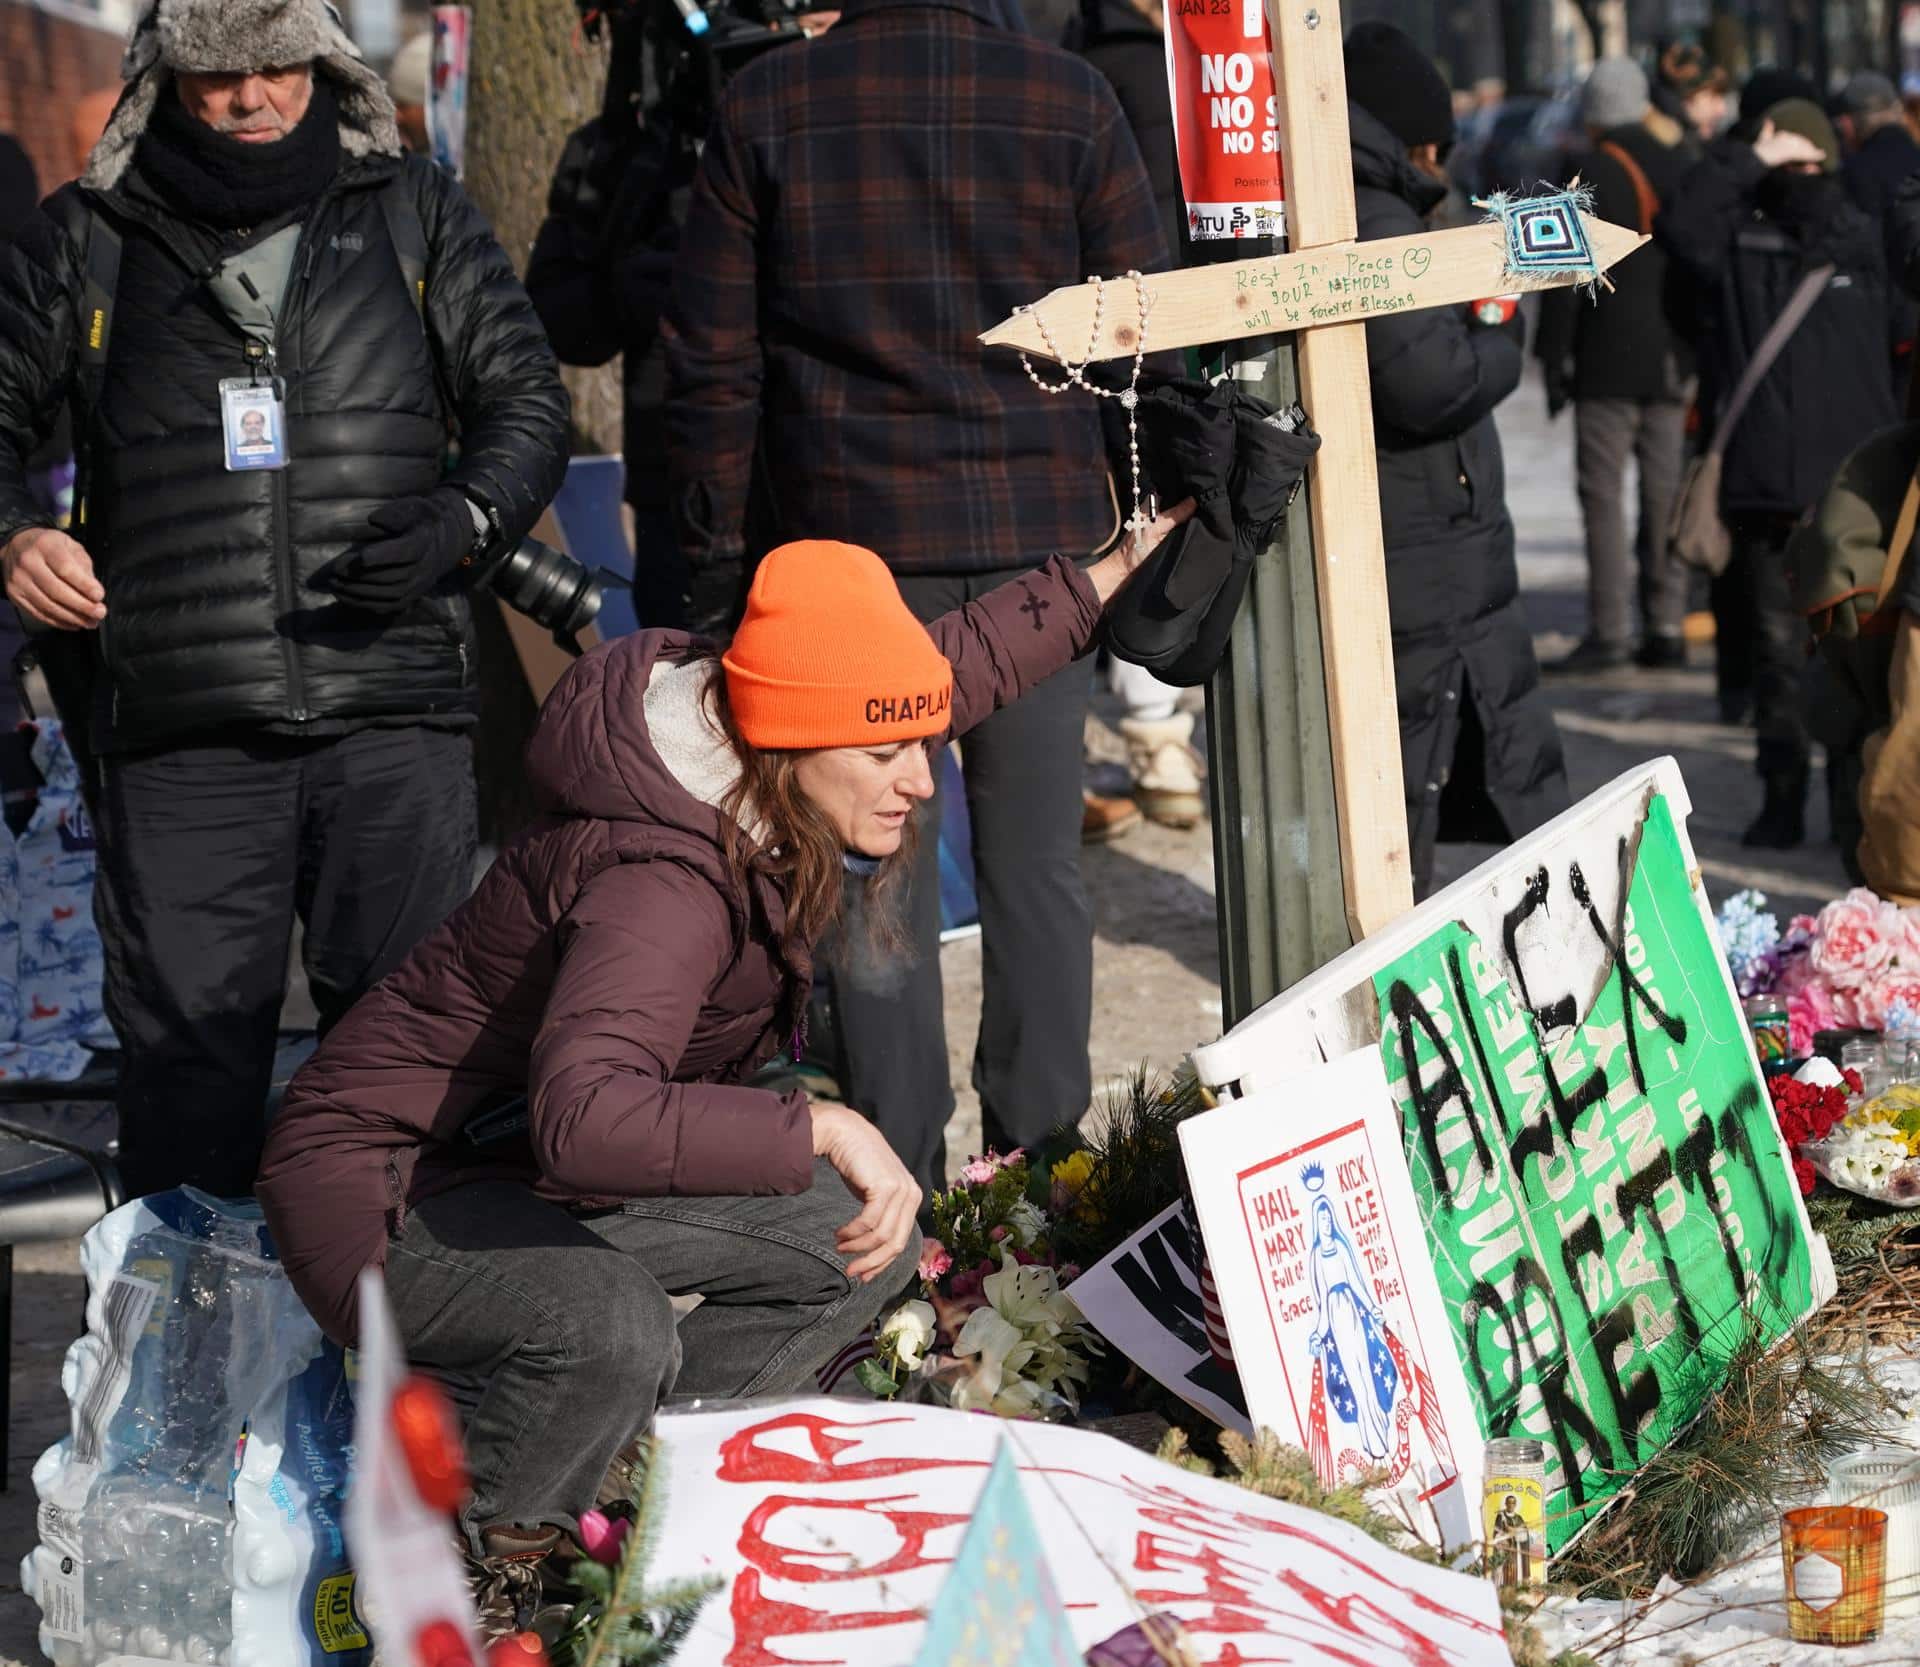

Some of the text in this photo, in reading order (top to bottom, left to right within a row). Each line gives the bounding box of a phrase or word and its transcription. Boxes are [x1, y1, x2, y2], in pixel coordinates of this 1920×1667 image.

[1175, 0, 1231, 16] JAN 23
[1201, 52, 1254, 94] NO
[1211, 96, 1255, 129] NO
[1222, 131, 1254, 154] NO
[1198, 216, 1225, 233] ATU
[1345, 253, 1393, 275] Peace
[1389, 835, 1687, 1210] ALEX
[1336, 1154, 1369, 1193] KICK
[1252, 1185, 1300, 1231] HAIL
[1264, 1223, 1307, 1267] MARY
[331, 1585, 350, 1616] 40
